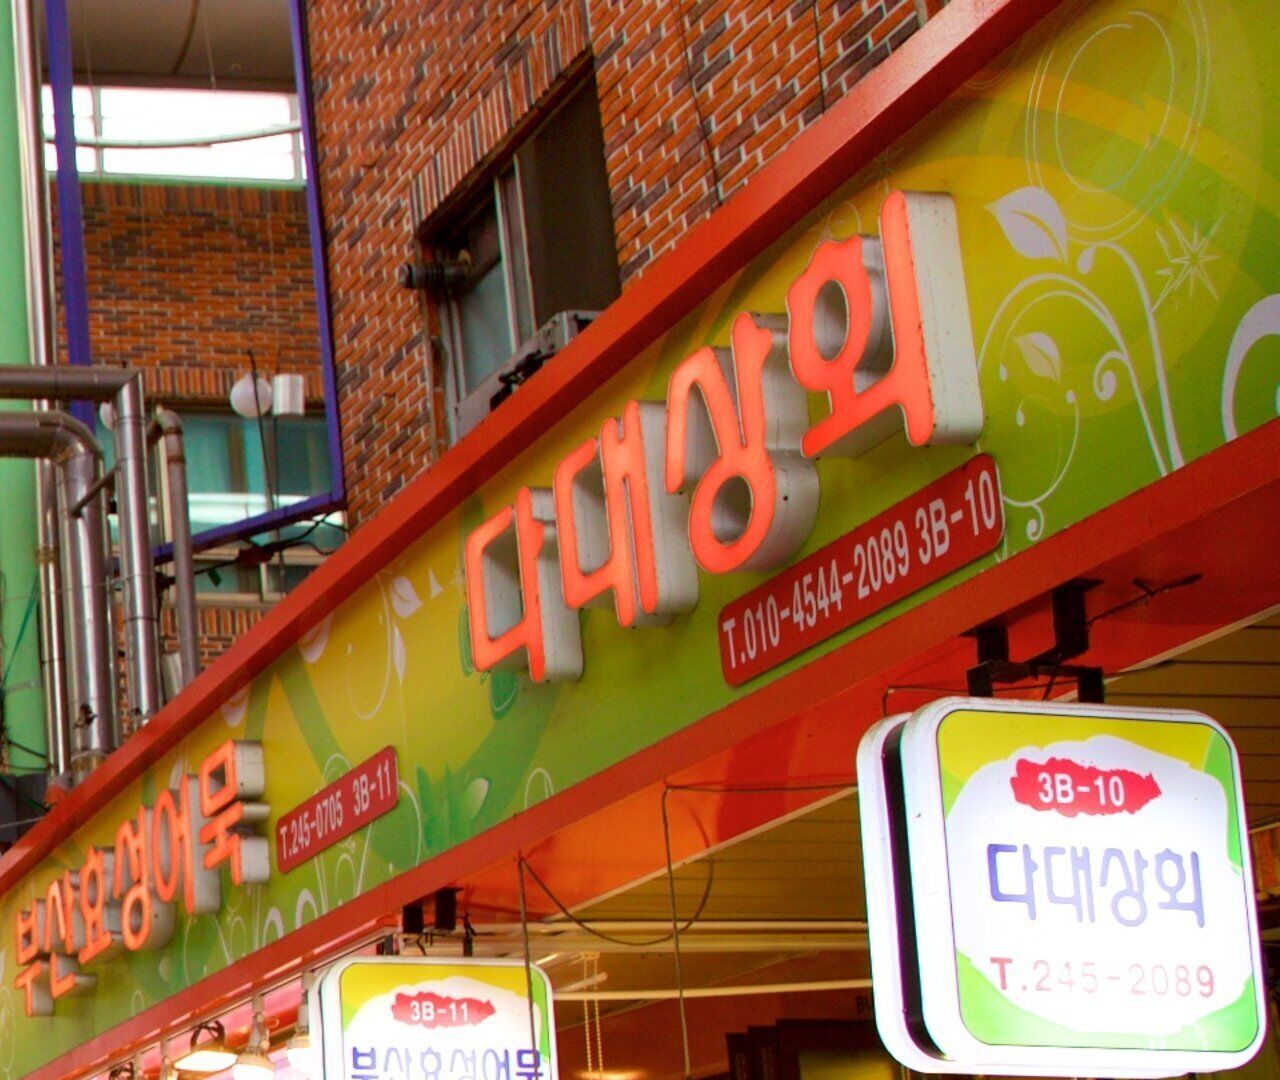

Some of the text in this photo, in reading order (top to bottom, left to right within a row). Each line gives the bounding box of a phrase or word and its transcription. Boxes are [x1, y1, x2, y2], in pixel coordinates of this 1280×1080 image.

[465, 190, 937, 683] 다대상회
[723, 469, 997, 670] T.010-4544-2089 3B-10
[280, 758, 393, 862] T.245-0705 3B-11
[1038, 771, 1126, 807] 3B-10
[14, 740, 245, 1017] 부산효성어묵
[987, 842, 1206, 928] 다대상회
[408, 1001, 470, 1023] 3B-11
[990, 956, 1215, 999] T.245-2089
